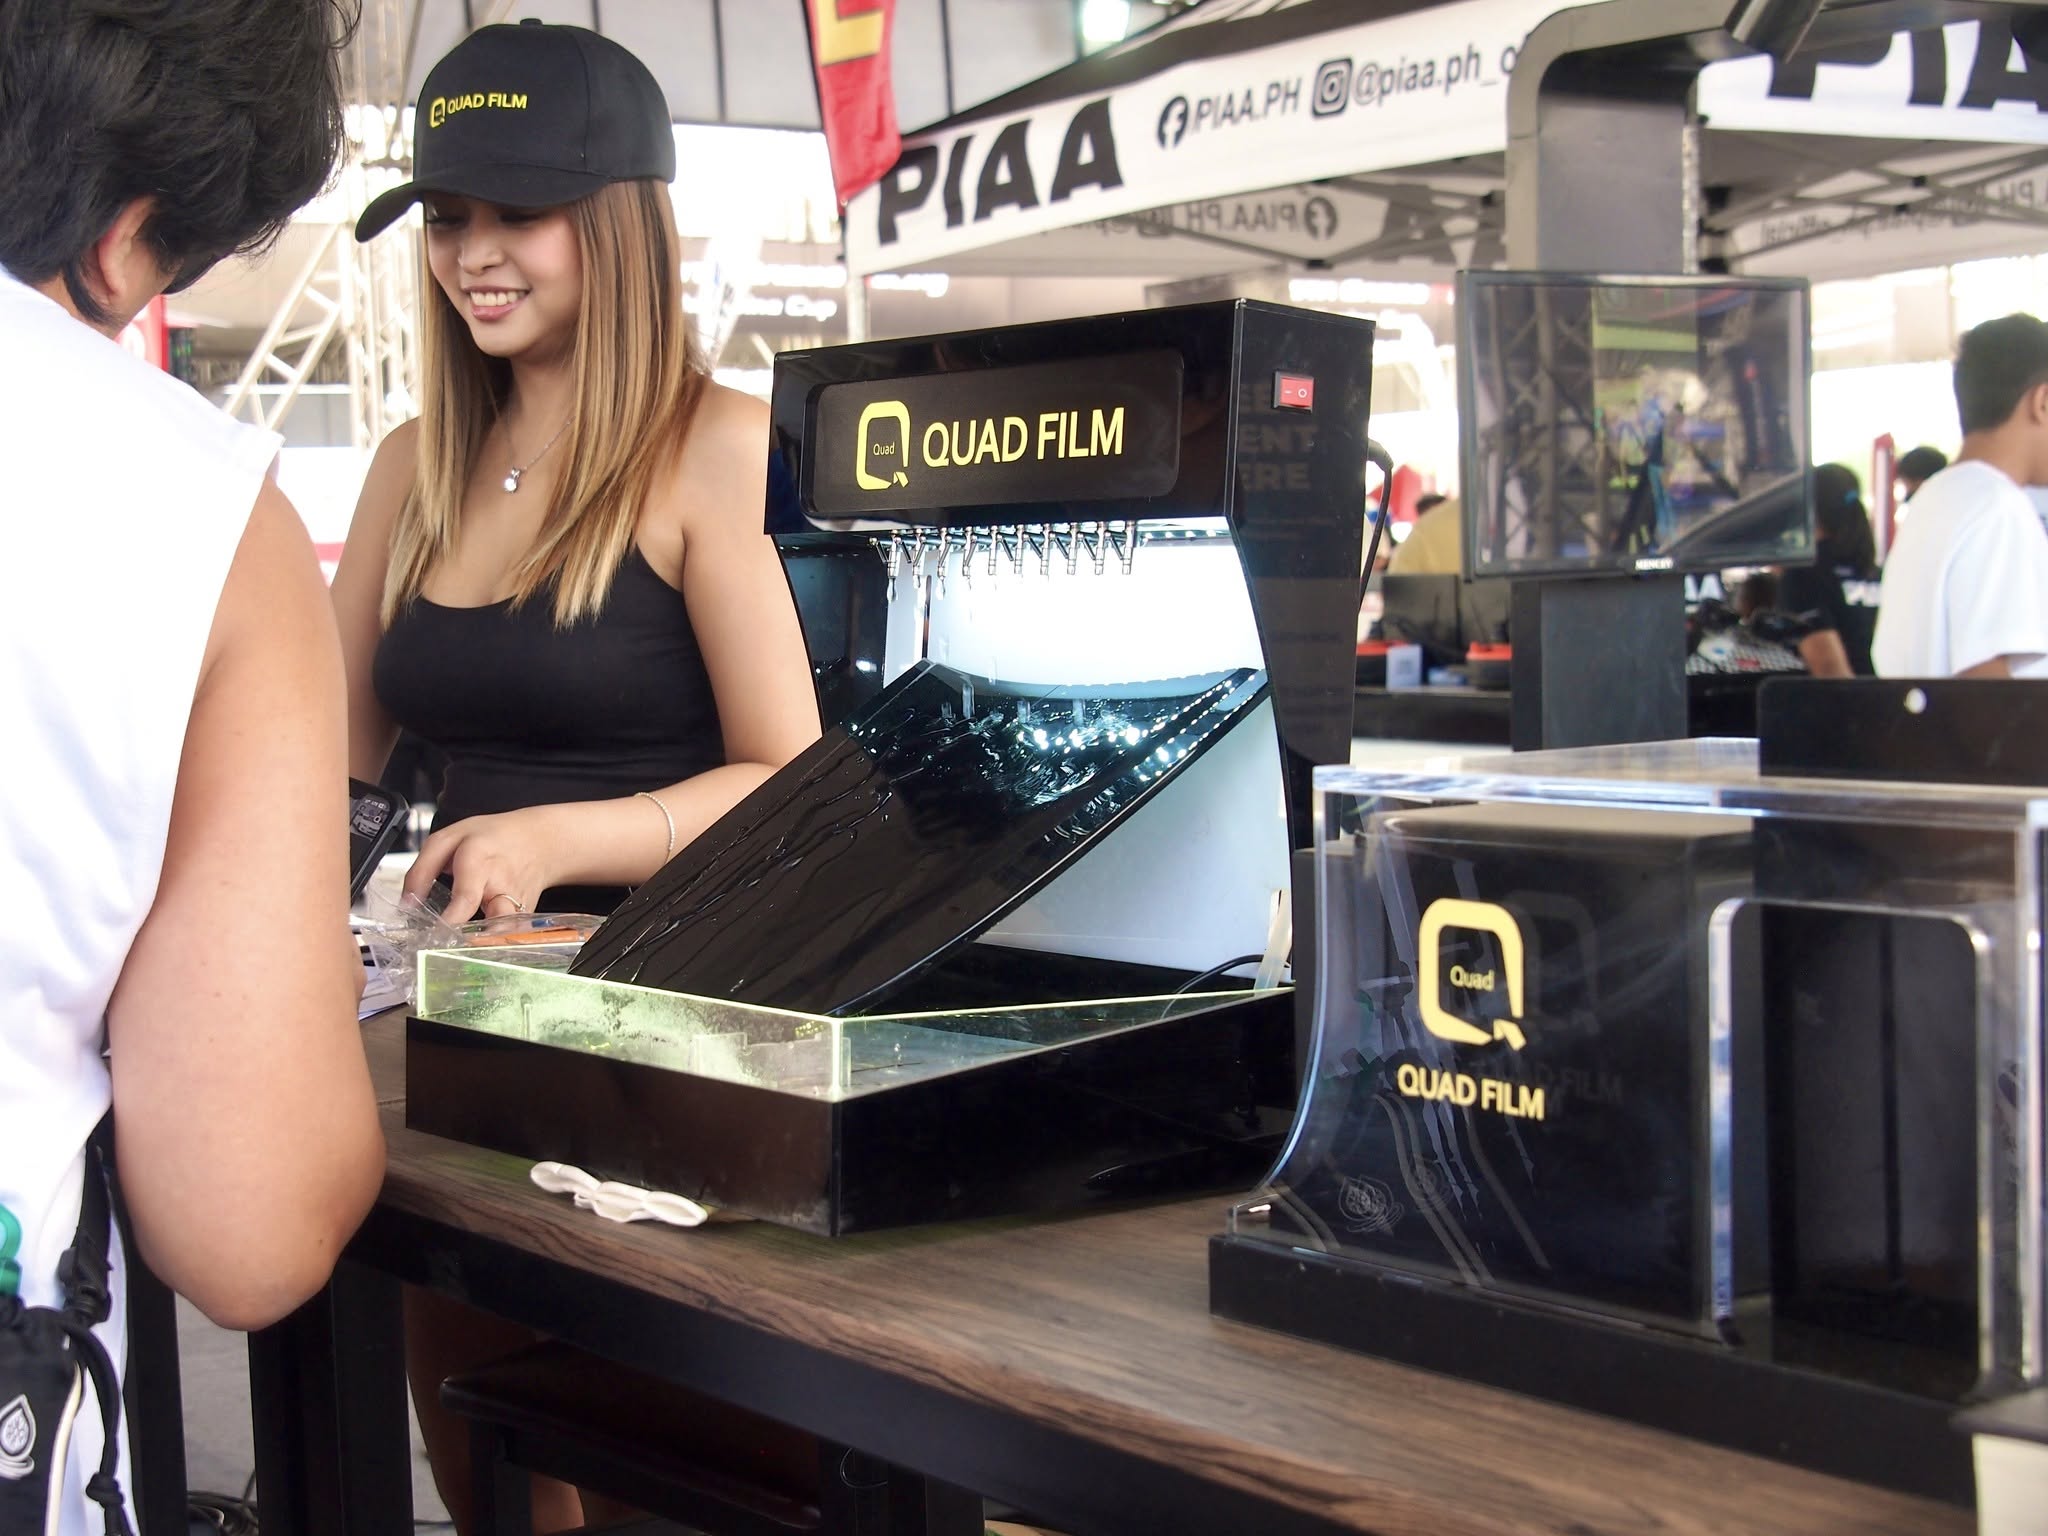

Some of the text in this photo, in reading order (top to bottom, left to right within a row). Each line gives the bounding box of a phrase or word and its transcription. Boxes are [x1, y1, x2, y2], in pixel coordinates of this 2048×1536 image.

[447, 92, 528, 114] QUAD FILM
[1192, 77, 1302, 133] PIAA.PH
[878, 96, 1124, 247] PIAA
[873, 442, 895, 456] Quad
[922, 407, 1125, 467] QUAD FILM
[1450, 965, 1495, 991] Quad
[1397, 1064, 1477, 1107] QUAD
[1480, 1078, 1545, 1121] FILM
